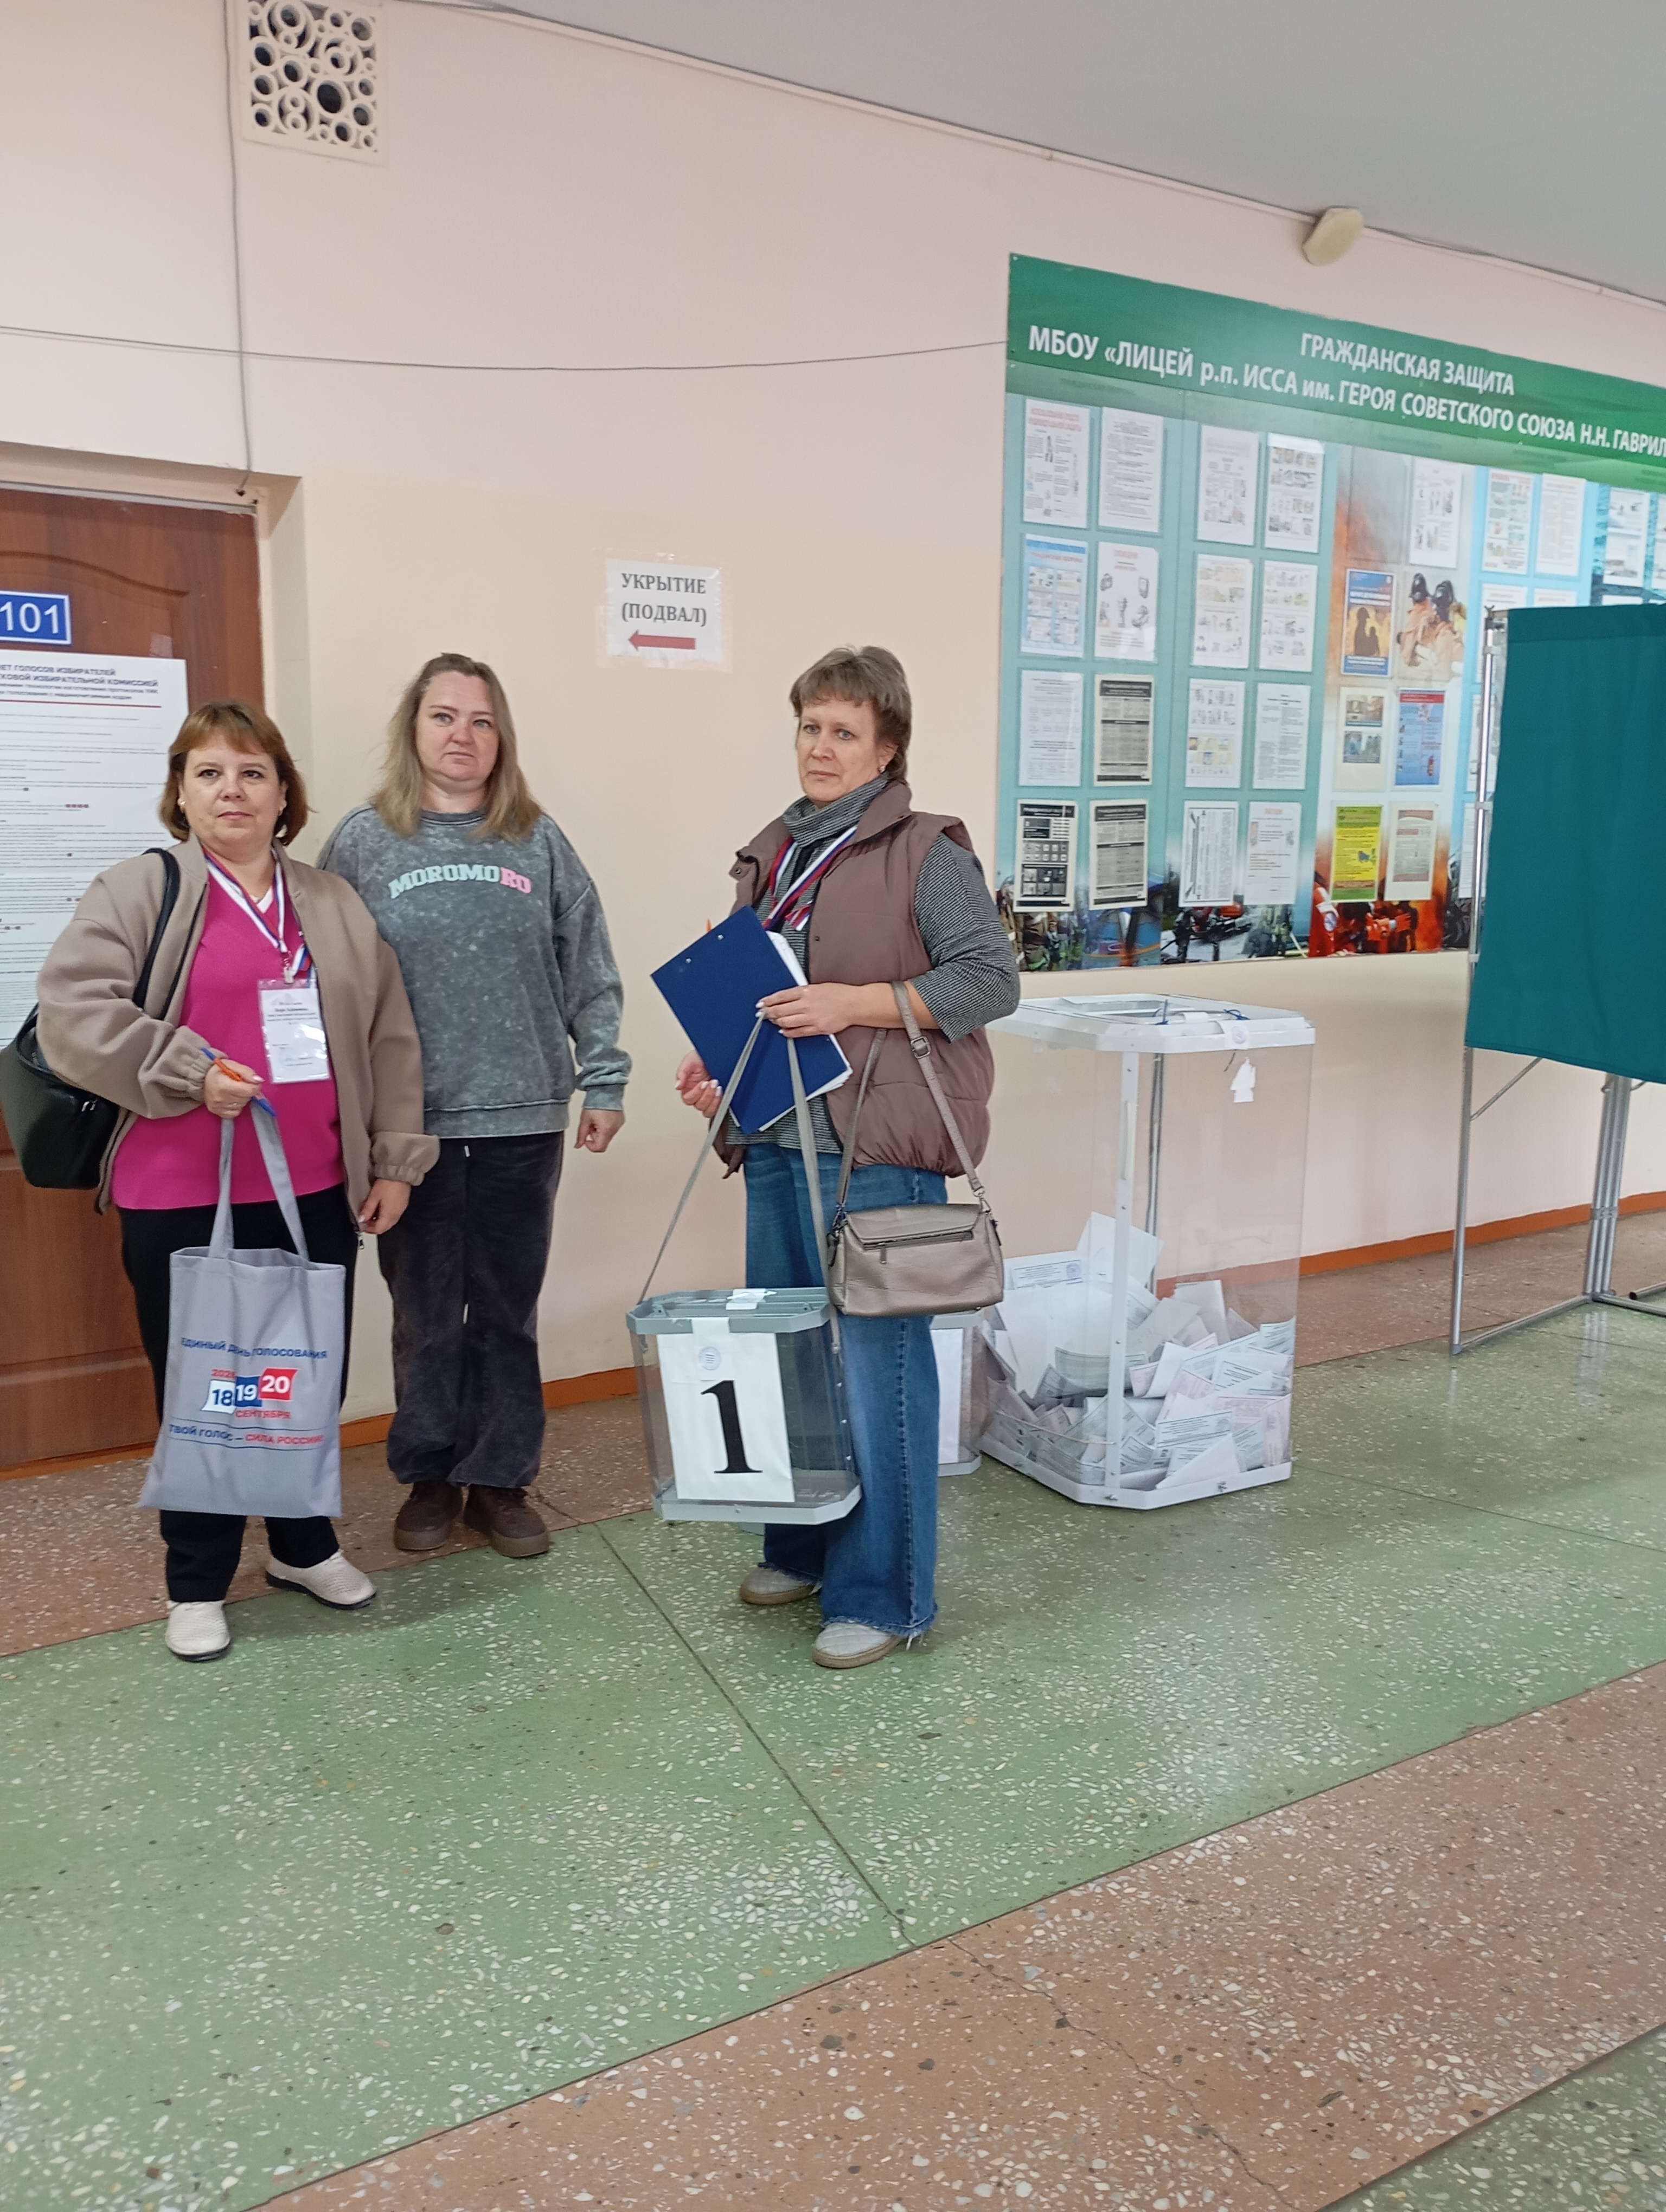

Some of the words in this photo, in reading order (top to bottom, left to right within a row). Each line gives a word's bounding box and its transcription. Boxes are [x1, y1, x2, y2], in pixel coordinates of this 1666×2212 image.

[1301, 332, 1440, 382] ГРАЖДАНСКАЯ
[1443, 362, 1514, 396] ЗАЩИТА
[1029, 325, 1099, 360] МБОУ
[1105, 341, 1193, 378] «ЛИЦЕЙ
[1201, 362, 1238, 385] р.п.
[1243, 364, 1297, 395] ИССА
[1303, 380, 1335, 402] им.
[1338, 381, 1396, 411] ГЕРОЯ
[1401, 392, 1514, 432] СОВЕТСКОГО
[1517, 413, 1575, 442] СОЮЗА
[1580, 423, 1611, 448] Н.Н.
[1613, 429, 1666, 458] ГАВРИЛ
[621, 573, 707, 594] УКРЫТИЕ
[0, 601, 59, 634] 101
[621, 602, 707, 627] (ПОДВАЛ)
[14, 665, 55, 673] ГОЛОСОВ
[388, 864, 532, 899] MOROMORO
[181, 1336, 226, 1351] ЕДИНЫЙ
[252, 1348, 328, 1359] ГОЛОСОВАНИЯ
[212, 1388, 233, 1407] 18
[236, 1384, 257, 1401] 19
[261, 1374, 291, 1394] 20
[236, 1410, 291, 1419] СЕНТЯБРЯ
[700, 1380, 764, 1474] 1
[169, 1424, 197, 1436] ТВОЙ
[198, 1429, 234, 1442] ГОЛОС
